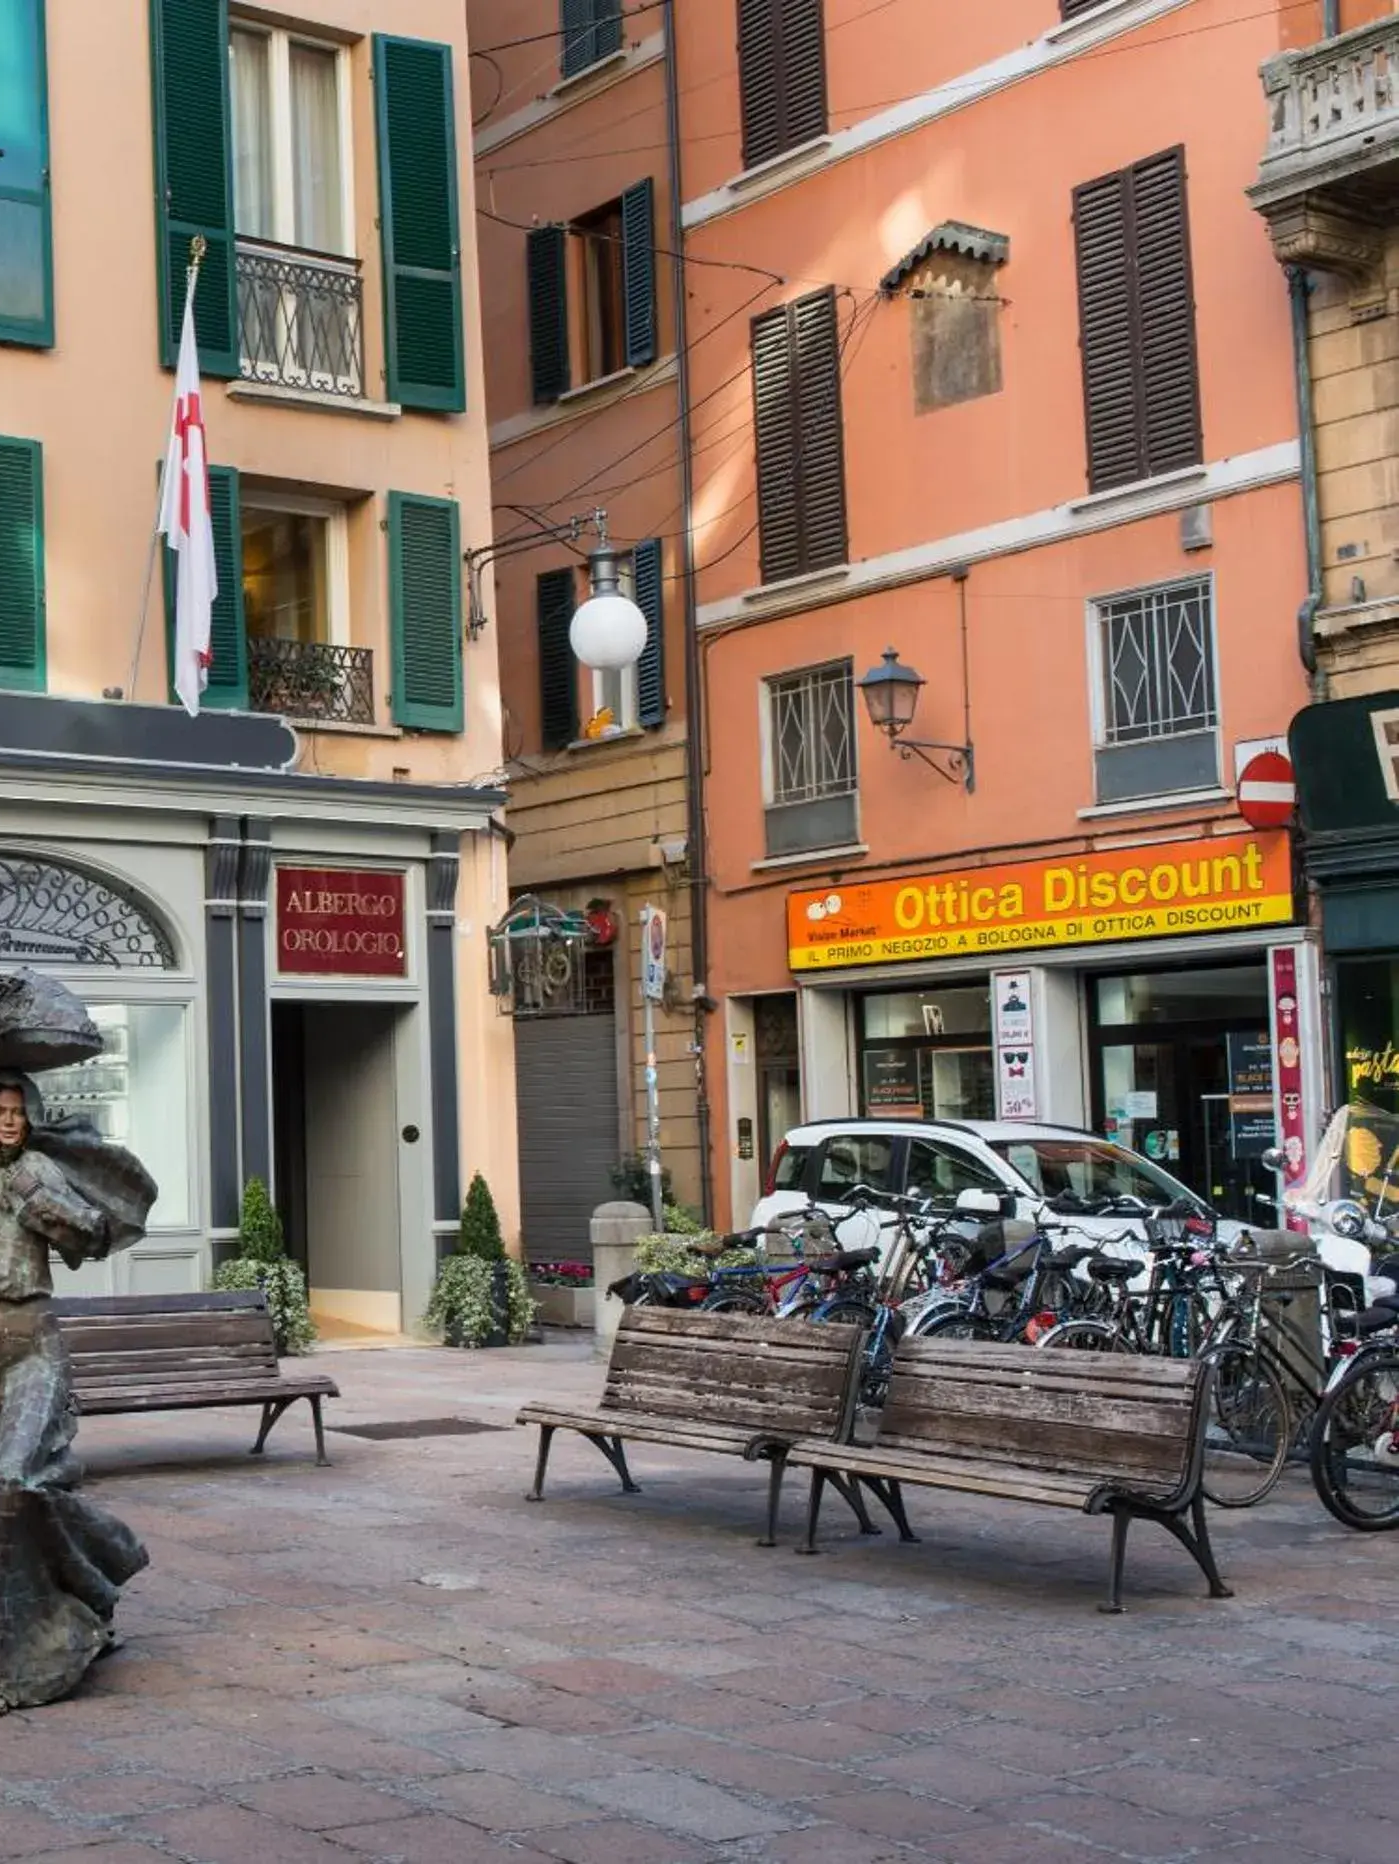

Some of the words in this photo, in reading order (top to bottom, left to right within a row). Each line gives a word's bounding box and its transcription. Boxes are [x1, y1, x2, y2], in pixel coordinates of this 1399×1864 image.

[285, 889, 397, 918] ALBERGO
[894, 879, 1025, 930] Ottica
[1043, 842, 1265, 912] Discount
[282, 928, 401, 955] OROLOGIO
[807, 950, 820, 963] IL
[826, 943, 873, 960] PRIMO
[881, 935, 948, 955] NEGOZIO
[957, 934, 968, 946] A
[977, 926, 1057, 946] BOLOGNA
[1065, 923, 1083, 937] DI
[1093, 913, 1157, 934] OTTICA
[1166, 902, 1264, 926] DISCOUNT
